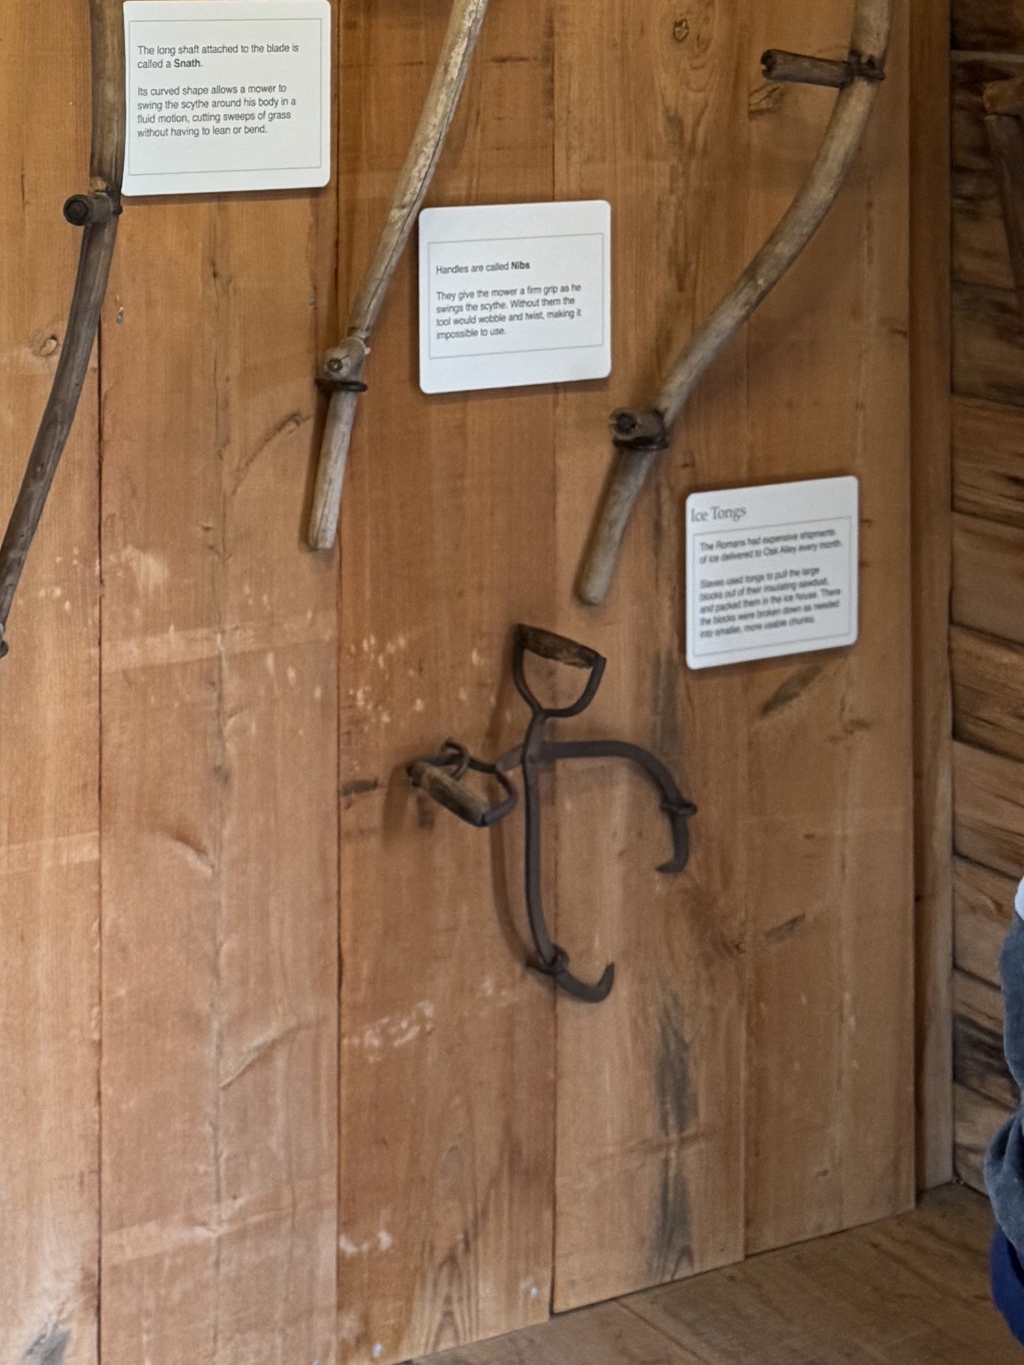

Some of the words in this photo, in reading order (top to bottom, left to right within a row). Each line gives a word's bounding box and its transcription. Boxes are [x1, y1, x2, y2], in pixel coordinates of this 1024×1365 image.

[137, 45, 155, 54] The
[156, 45, 176, 56] long
[177, 44, 199, 54] shaft
[201, 44, 238, 53] attached
[240, 45, 249, 53] to
[250, 44, 264, 52] the
[266, 43, 290, 52] blade
[291, 43, 299, 52] is
[137, 59, 163, 68] called
[173, 58, 202, 67] Snath.
[137, 87, 148, 96] Its
[150, 86, 180, 95] curved
[182, 86, 209, 95] shape
[210, 85, 238, 94] allows
[278, 84, 287, 92] to
[137, 101, 162, 111] swing
[164, 100, 179, 109] the
[180, 99, 209, 110] scythe
[211, 98, 241, 108] around
[243, 98, 256, 106] his
[258, 97, 279, 108] body
[280, 97, 288, 105] in
[137, 114, 155, 123] fluid
[157, 113, 189, 123] motion,
[191, 112, 221, 123] cutting
[222, 113, 255, 122] sweeps
[257, 111, 266, 120] of
[267, 113, 291, 122] grass
[137, 128, 168, 137] without
[170, 127, 199, 137] having
[201, 126, 210, 135] to
[212, 126, 231, 134] lean
[243, 124, 267, 134] bend.
[435, 264, 468, 273] Handles
[485, 262, 509, 271] called
[510, 261, 530, 269] Nibs
[436, 291, 456, 301] They
[457, 291, 475, 301] give
[476, 289, 489, 297] the
[526, 286, 542, 294] firm
[542, 285, 558, 295] grip
[436, 305, 463, 314] swings
[465, 303, 478, 311] the
[509, 298, 540, 308] Without
[541, 298, 561, 306] them
[562, 297, 575, 305] the
[435, 317, 451, 326] tool
[452, 315, 476, 324] would
[477, 313, 506, 323] wobble
[507, 312, 523, 321] and
[546, 310, 574, 319] making
[436, 328, 478, 340] impossible
[479, 328, 488, 336] to
[691, 509, 708, 521] Ice
[710, 506, 747, 520] Tongs
